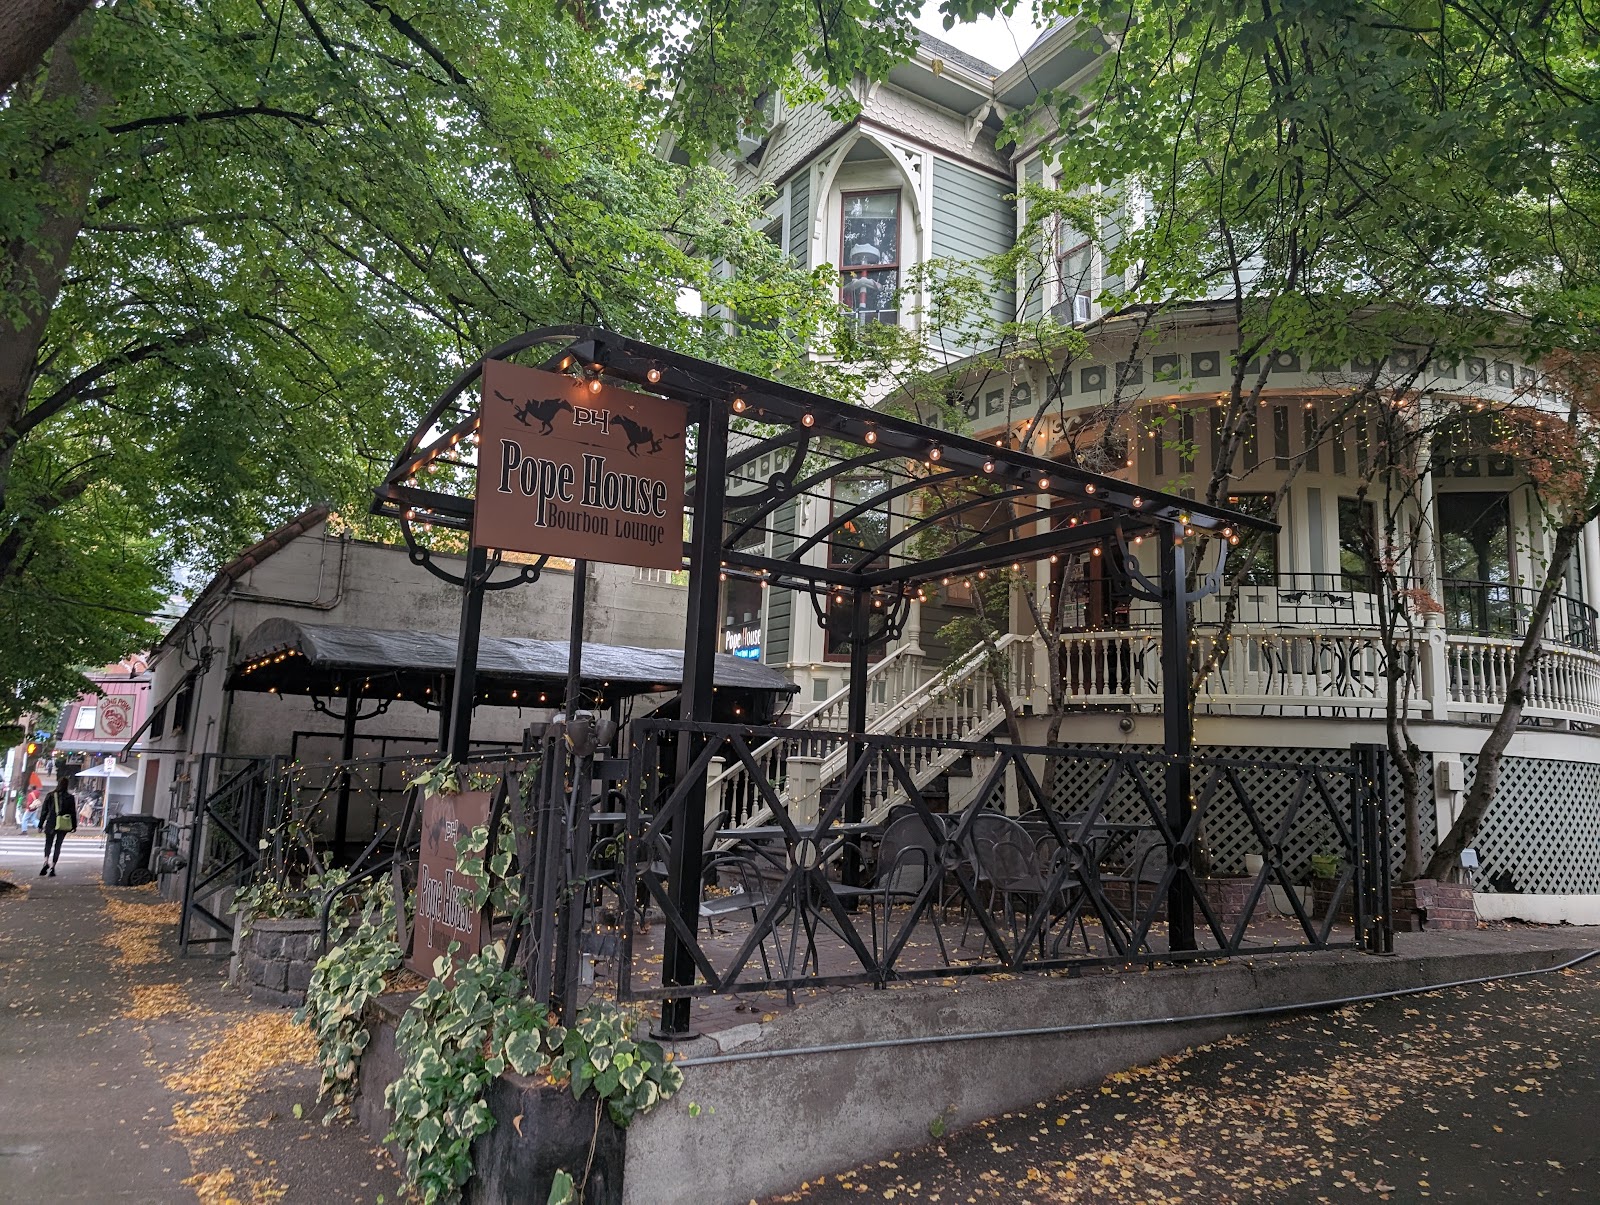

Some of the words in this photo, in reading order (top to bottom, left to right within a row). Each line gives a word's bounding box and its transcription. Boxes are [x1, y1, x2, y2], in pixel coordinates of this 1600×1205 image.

[572, 405, 611, 435] PH
[497, 438, 575, 528] Pope
[580, 453, 668, 519] House
[548, 502, 609, 536] Bourbon
[615, 519, 665, 547] Lounge
[726, 631, 741, 656] Pope
[743, 628, 761, 646] House
[444, 819, 459, 846] PH
[420, 864, 442, 948] Pope
